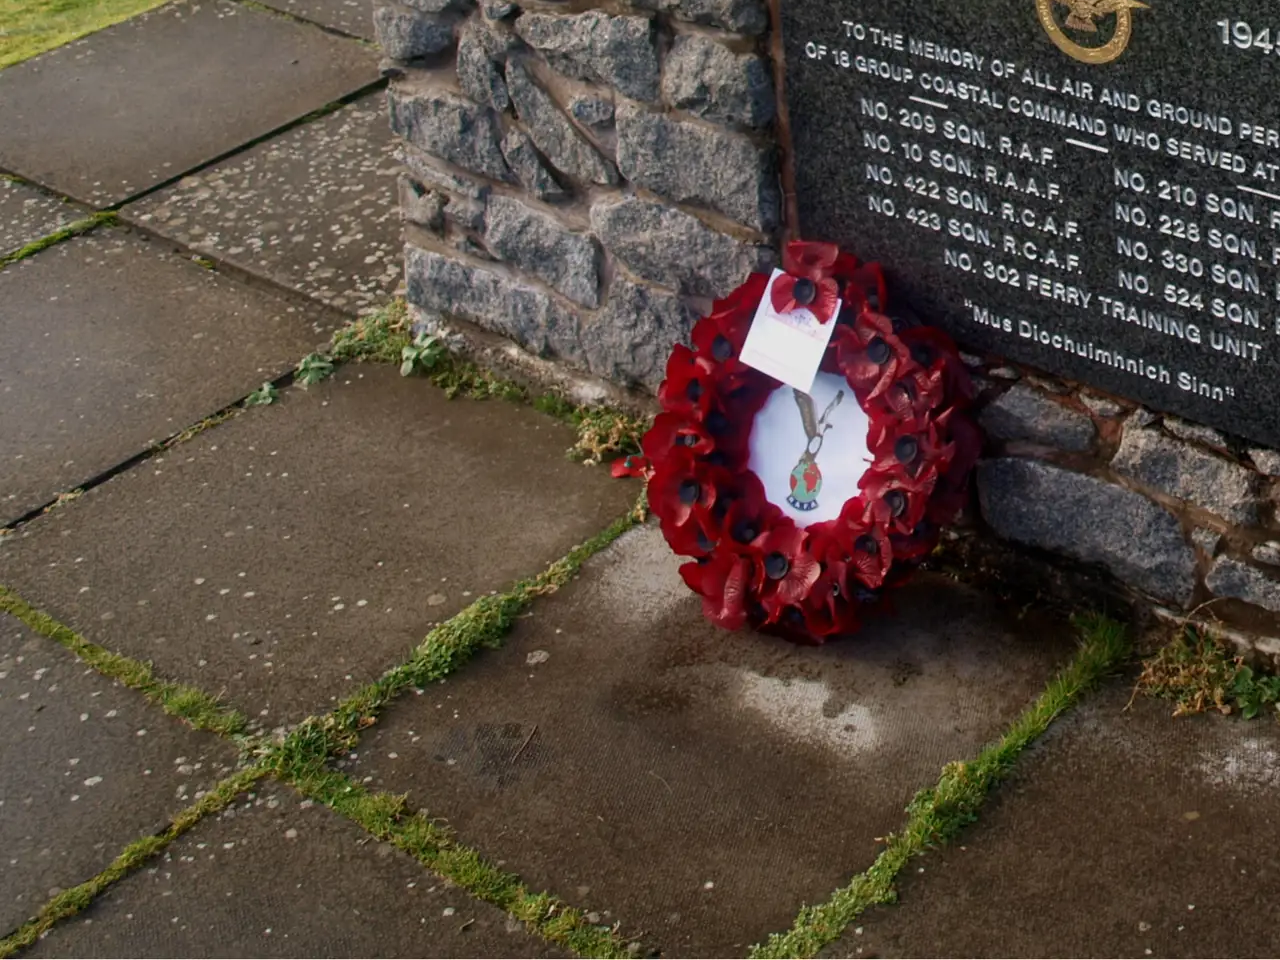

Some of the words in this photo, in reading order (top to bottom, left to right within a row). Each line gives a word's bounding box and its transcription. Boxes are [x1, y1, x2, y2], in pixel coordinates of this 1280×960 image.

[805, 41, 827, 60] OF
[832, 50, 851, 68] 18
[855, 55, 913, 83] GROUP
[920, 72, 1002, 109] COASTAL
[1008, 96, 1106, 136] COMMAND
[1113, 124, 1160, 150] WHO
[1167, 138, 1246, 173] SERVED
[1253, 161, 1280, 181] AT
[842, 21, 865, 40] TO
[869, 27, 903, 51] THE
[909, 39, 984, 72] MEMORY
[991, 59, 1015, 78] OF
[1022, 70, 1057, 91] ALL
[1061, 78, 1093, 100] AIR
[1100, 89, 1140, 112] AND
[1147, 99, 1232, 136] GROUND
[861, 98, 892, 122] NO.
[899, 108, 936, 134] 209
[943, 121, 991, 149] SQN.
[1000, 137, 1057, 168] R.A.F.
[863, 132, 895, 154] NO.
[901, 143, 922, 162] 10
[929, 149, 977, 179] SQN.
[985, 166, 1063, 203] R.A.A.F.
[865, 164, 897, 187] NO.
[903, 176, 940, 199] 422
[946, 187, 994, 215] SQN.
[1002, 202, 1081, 241] R.C.A.F.
[1114, 168, 1150, 194] NO.
[1158, 180, 1197, 206] 210
[1205, 193, 1261, 224] SQN.
[868, 195, 899, 219] NO.
[906, 207, 941, 231] 423
[948, 219, 996, 248] SQN.
[1003, 235, 1083, 274] R.C.A.F.
[1115, 203, 1151, 228] NO.
[1159, 215, 1200, 242] 228
[1208, 228, 1262, 260] SQN.
[1117, 236, 1153, 263] NO.
[1161, 250, 1203, 277] 330
[1211, 264, 1266, 297] SQN.
[944, 249, 977, 273] NO.
[983, 261, 1020, 287] 302
[1027, 275, 1091, 309] FERRY
[1098, 296, 1201, 344] TRAINING
[1210, 330, 1262, 362] UNIT
[1118, 270, 1154, 296] NO.
[1164, 284, 1203, 311] 524
[1212, 298, 1266, 330] SQN.
[1019, 320, 1171, 384] Diochuimhnich
